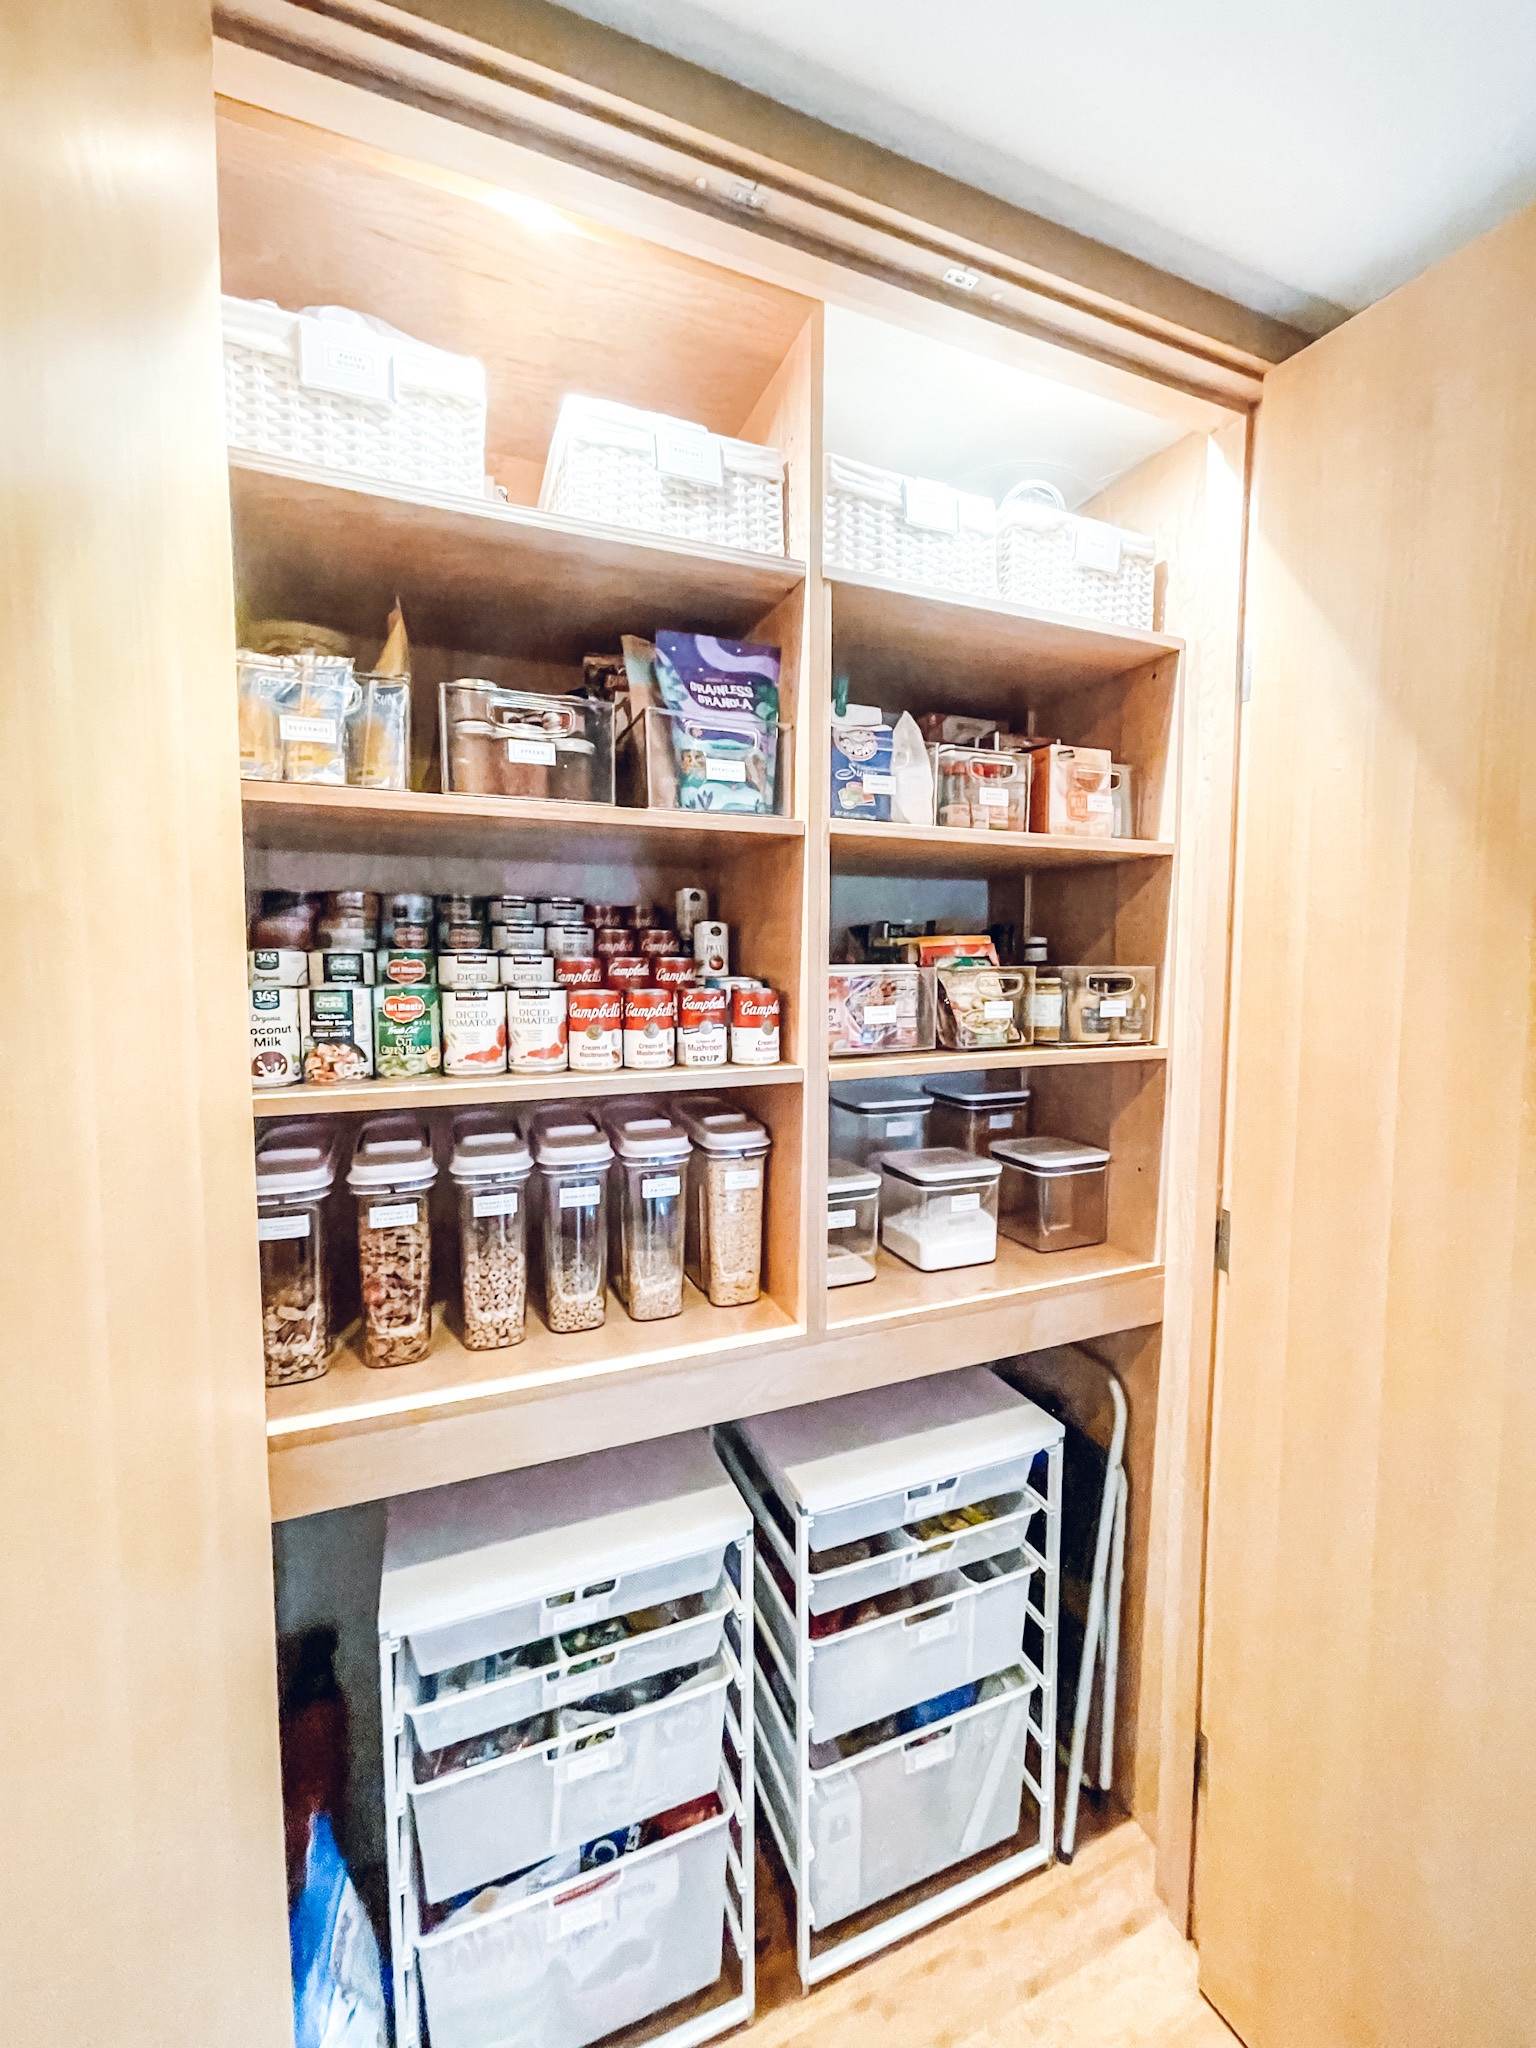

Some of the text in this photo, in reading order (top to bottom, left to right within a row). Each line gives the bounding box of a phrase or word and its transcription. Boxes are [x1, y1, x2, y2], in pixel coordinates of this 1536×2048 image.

[690, 681, 754, 698] GRAINLESS
[697, 695, 753, 711] GRANOLA
[256, 953, 277, 963] 365
[255, 991, 278, 1002] 365
[385, 1002, 423, 1011] Del Monte
[456, 1010, 488, 1019] DICED
[519, 1008, 549, 1017] DICED
[448, 1018, 497, 1028] TOMATOES
[511, 1016, 558, 1025] TOMATOES
[250, 1025, 292, 1035] oconut
[254, 1037, 282, 1047] Milk
